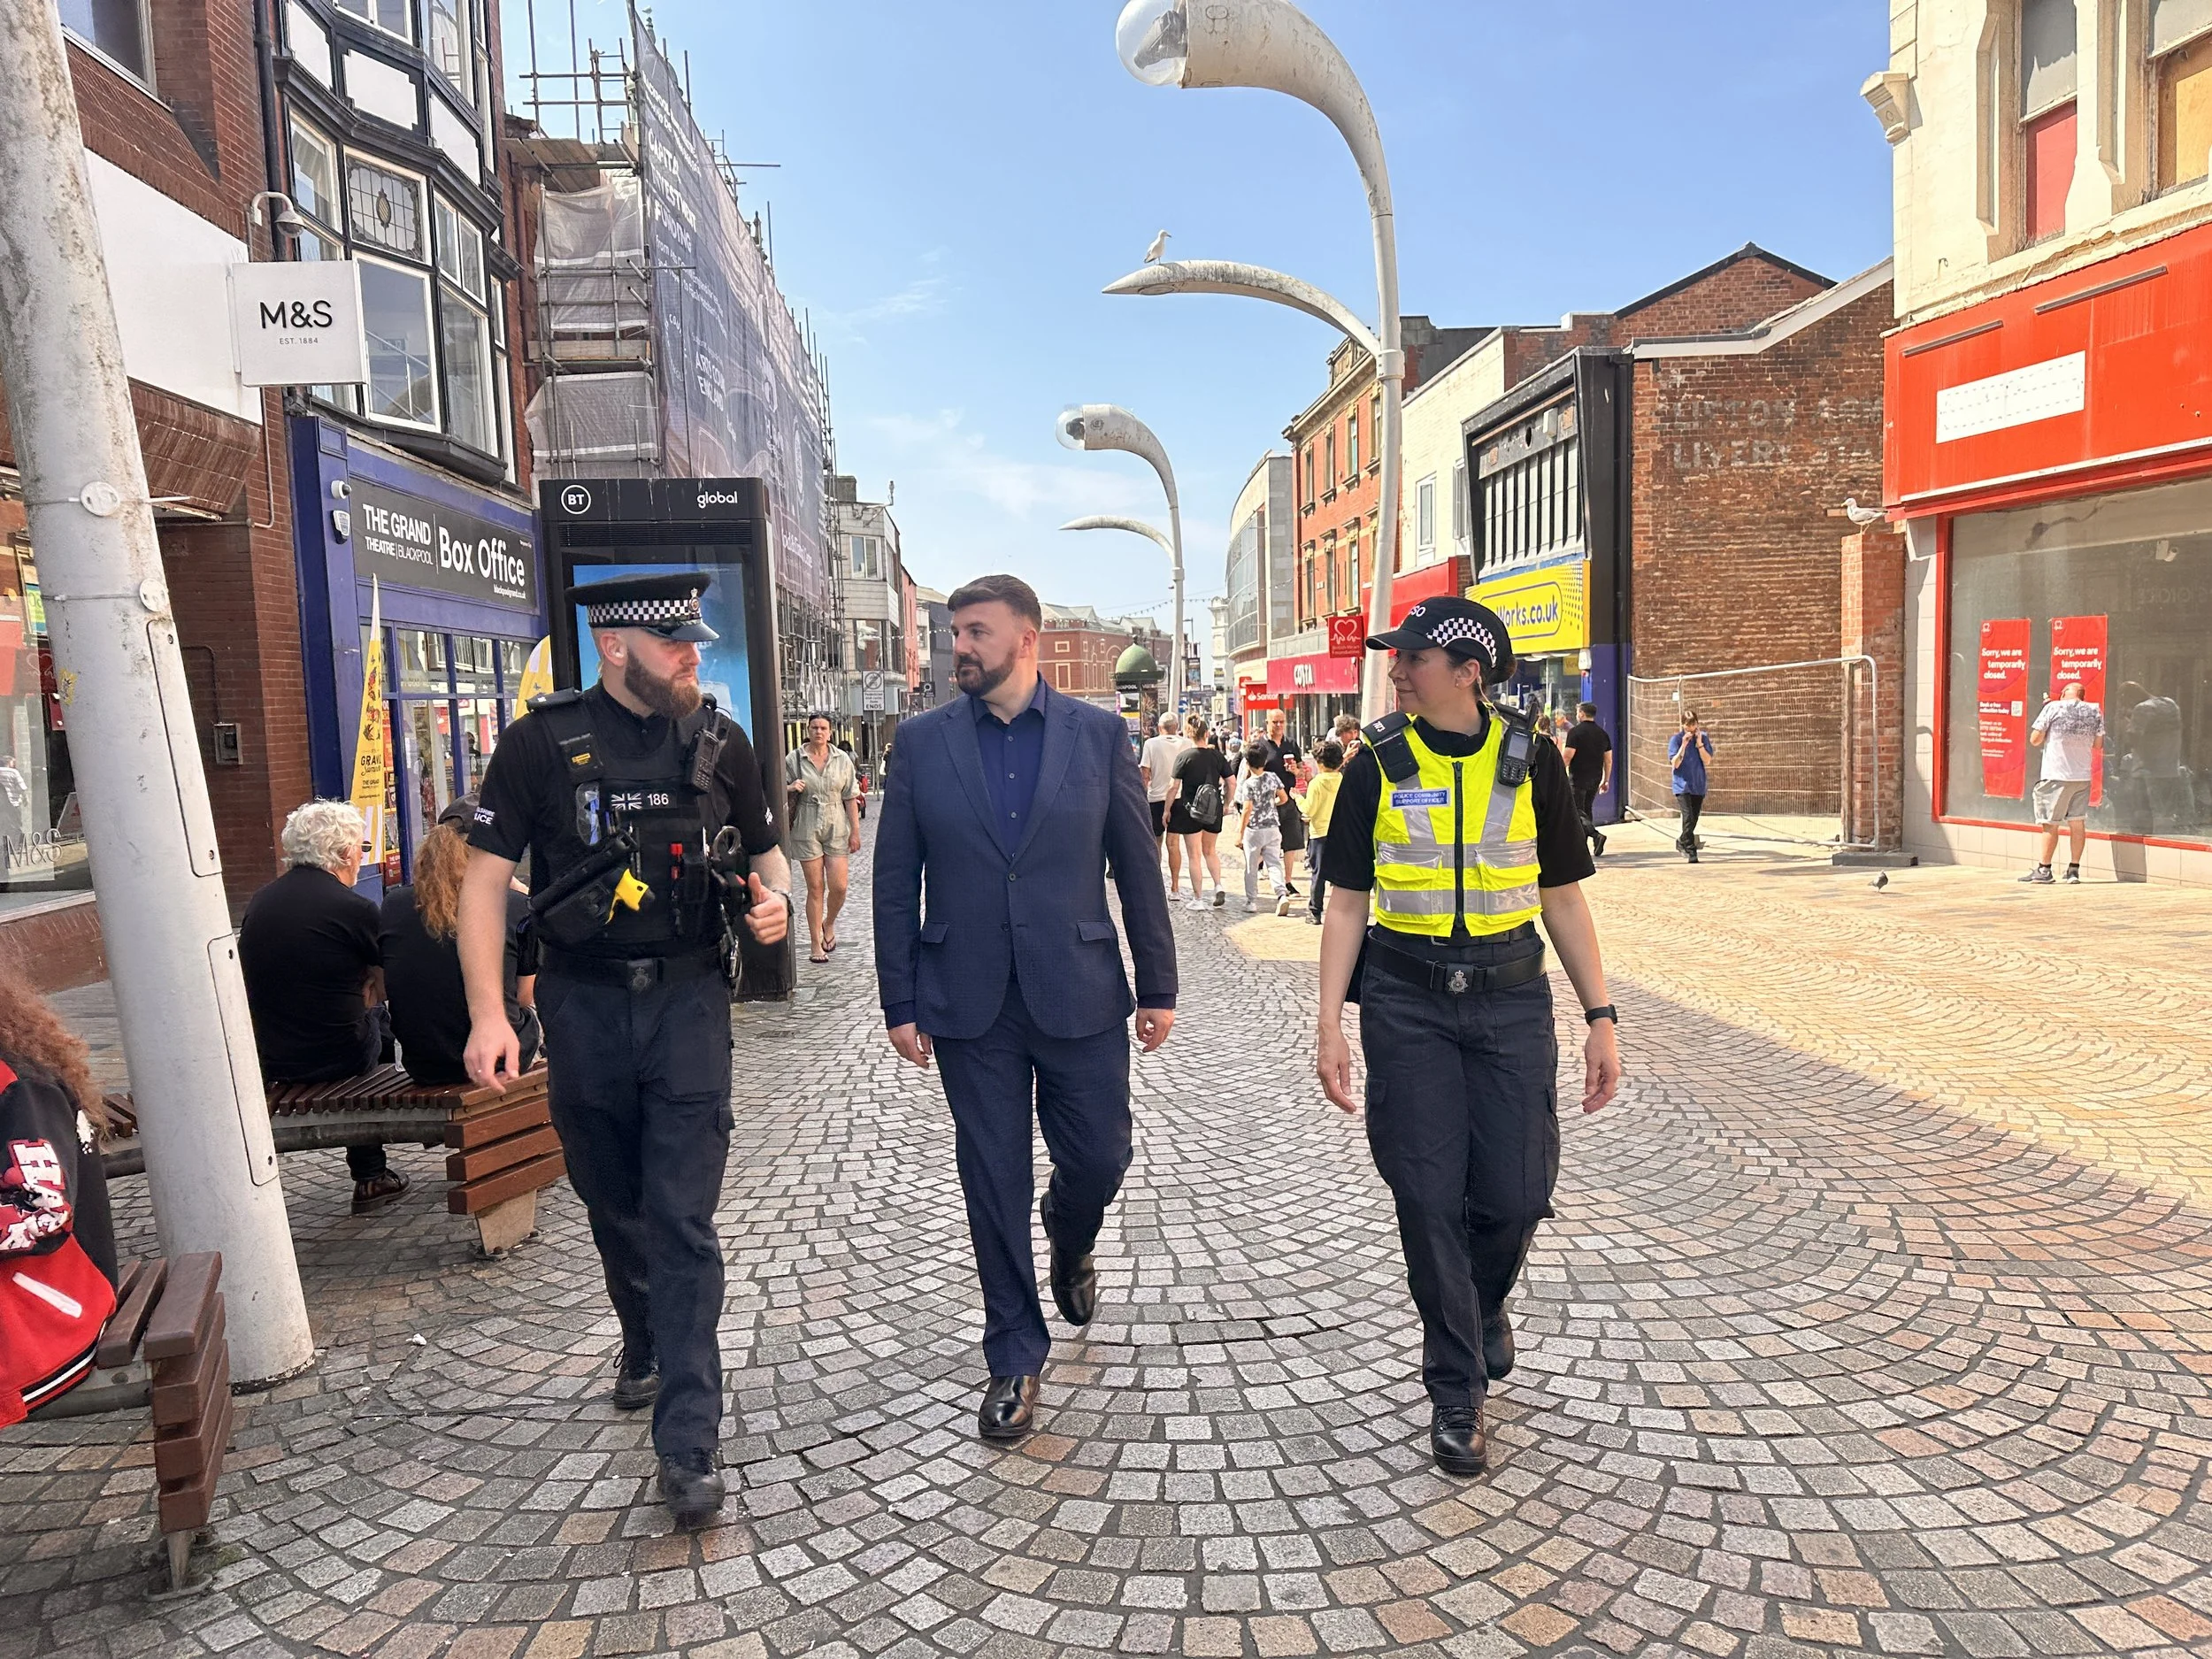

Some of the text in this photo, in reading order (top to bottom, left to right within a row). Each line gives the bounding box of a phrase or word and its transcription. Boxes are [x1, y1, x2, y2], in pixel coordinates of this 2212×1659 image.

[259, 299, 333, 329] M&S
[1673, 440, 1793, 470] LIVERY
[567, 494, 585, 505] BT
[696, 490, 738, 509] global
[363, 503, 388, 535] THE
[390, 511, 432, 546] GRAND
[365, 535, 434, 565] THEATRE BLACKPOOL
[439, 526, 526, 587] Box Office
[1982, 648, 2000, 658] Sorry,
[2054, 646, 2074, 657] Sorry,
[1987, 659, 2025, 671] temporarily
[2062, 658, 2102, 670] temporarily
[1294, 664, 1314, 687] COSTA
[1984, 670, 2007, 679] closed.
[2057, 670, 2081, 680] closed.
[647, 793, 669, 806] 186
[473, 812, 493, 825] LICE
[6, 828, 63, 868] M&S
